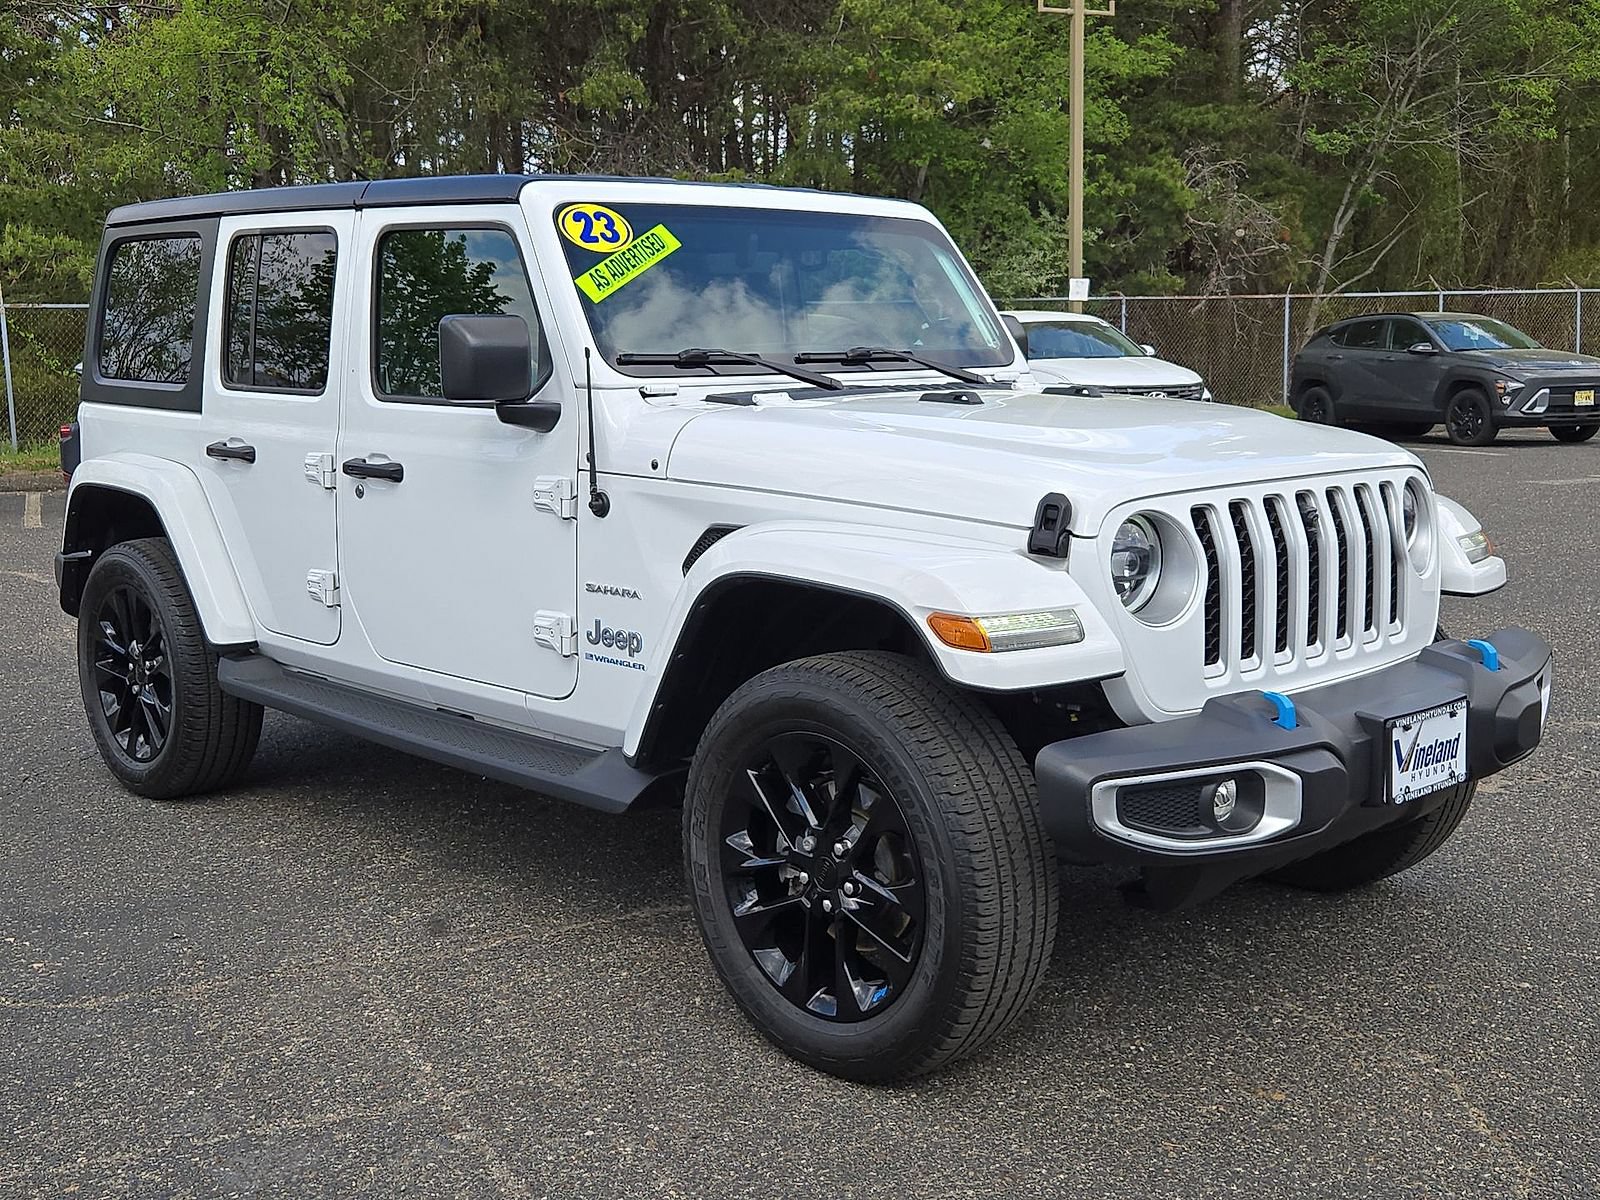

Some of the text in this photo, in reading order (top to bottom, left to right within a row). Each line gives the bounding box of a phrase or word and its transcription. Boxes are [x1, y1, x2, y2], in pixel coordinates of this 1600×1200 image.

[573, 211, 620, 243] 23
[589, 232, 666, 291] AS ADVERTISED
[585, 583, 642, 600] SAHARA
[586, 618, 642, 657] Jeep
[594, 654, 646, 671] WRANGLER
[1394, 720, 1461, 774] Vineland
[1411, 760, 1458, 782] HYUNDAI
